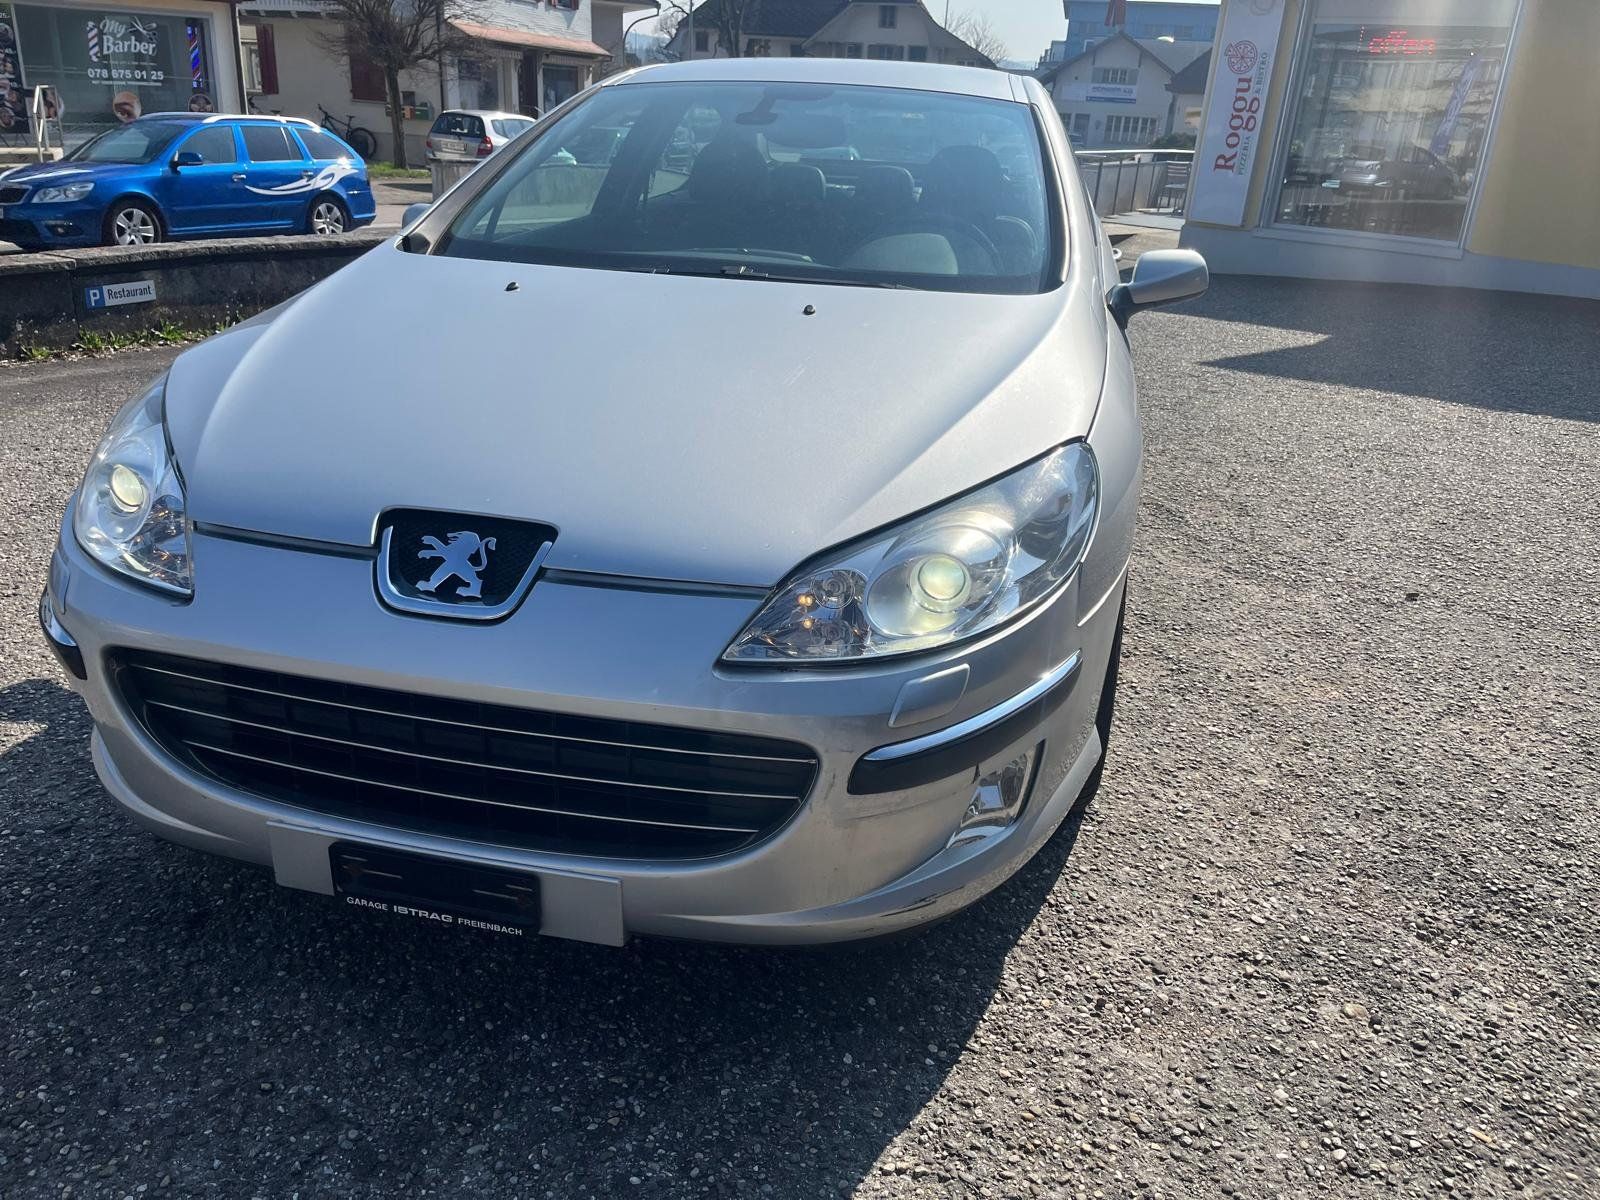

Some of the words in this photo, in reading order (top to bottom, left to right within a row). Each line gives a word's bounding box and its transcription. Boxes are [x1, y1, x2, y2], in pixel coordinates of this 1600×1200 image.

[100, 18, 126, 38] My
[102, 35, 156, 55] Barber
[87, 68, 109, 78] 078
[111, 69, 132, 79] 675
[134, 70, 147, 80] 01
[150, 71, 164, 81] 25
[1213, 76, 1261, 173] Roggu
[89, 289, 100, 307] P
[107, 284, 152, 300] Restaurant
[346, 896, 388, 911] GARAGE
[393, 905, 453, 923] ISTRAG
[458, 917, 523, 936] FREIENBACH
